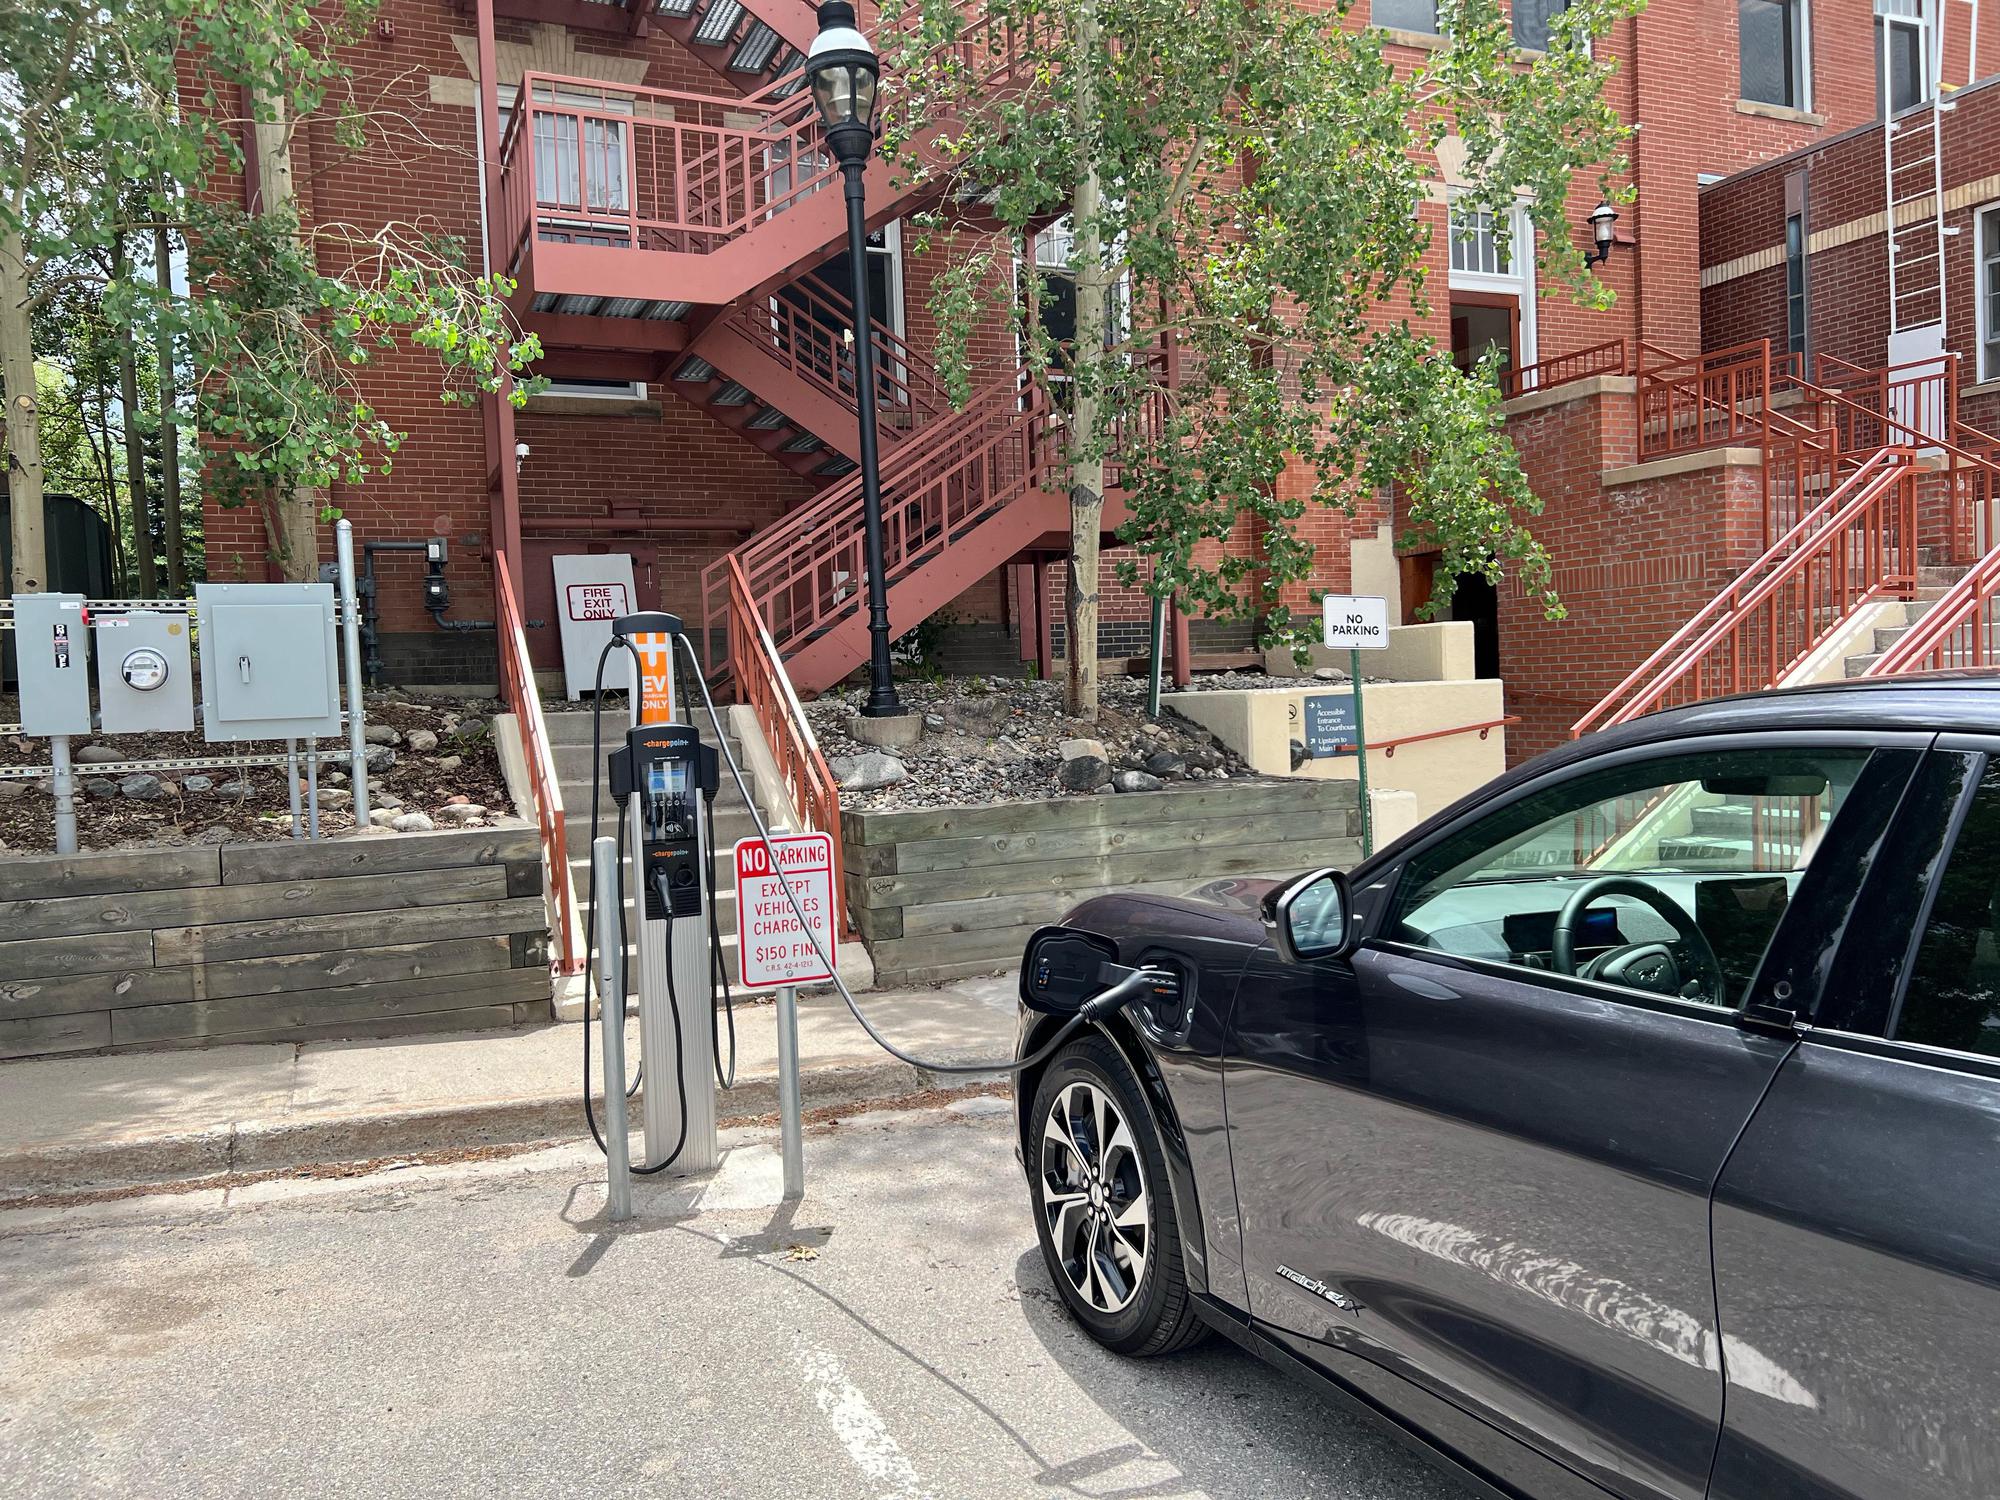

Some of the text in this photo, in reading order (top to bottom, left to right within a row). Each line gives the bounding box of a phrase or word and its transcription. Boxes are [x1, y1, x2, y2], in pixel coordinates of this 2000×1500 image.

[583, 588, 611, 597] FIRE
[585, 598, 612, 608] EXIT
[583, 608, 615, 619] ONLY
[1346, 614, 1363, 624] NO
[1332, 625, 1380, 636] PARKING
[642, 675, 667, 692] EV
[642, 700, 668, 710] ONLY
[1317, 708, 1346, 717] Accessible
[1317, 717, 1341, 725] Entrance
[741, 845, 825, 873] NO PARKING
[761, 879, 811, 897] EXCEPT
[754, 897, 819, 917] VEHICES
[756, 945, 787, 963] $150
